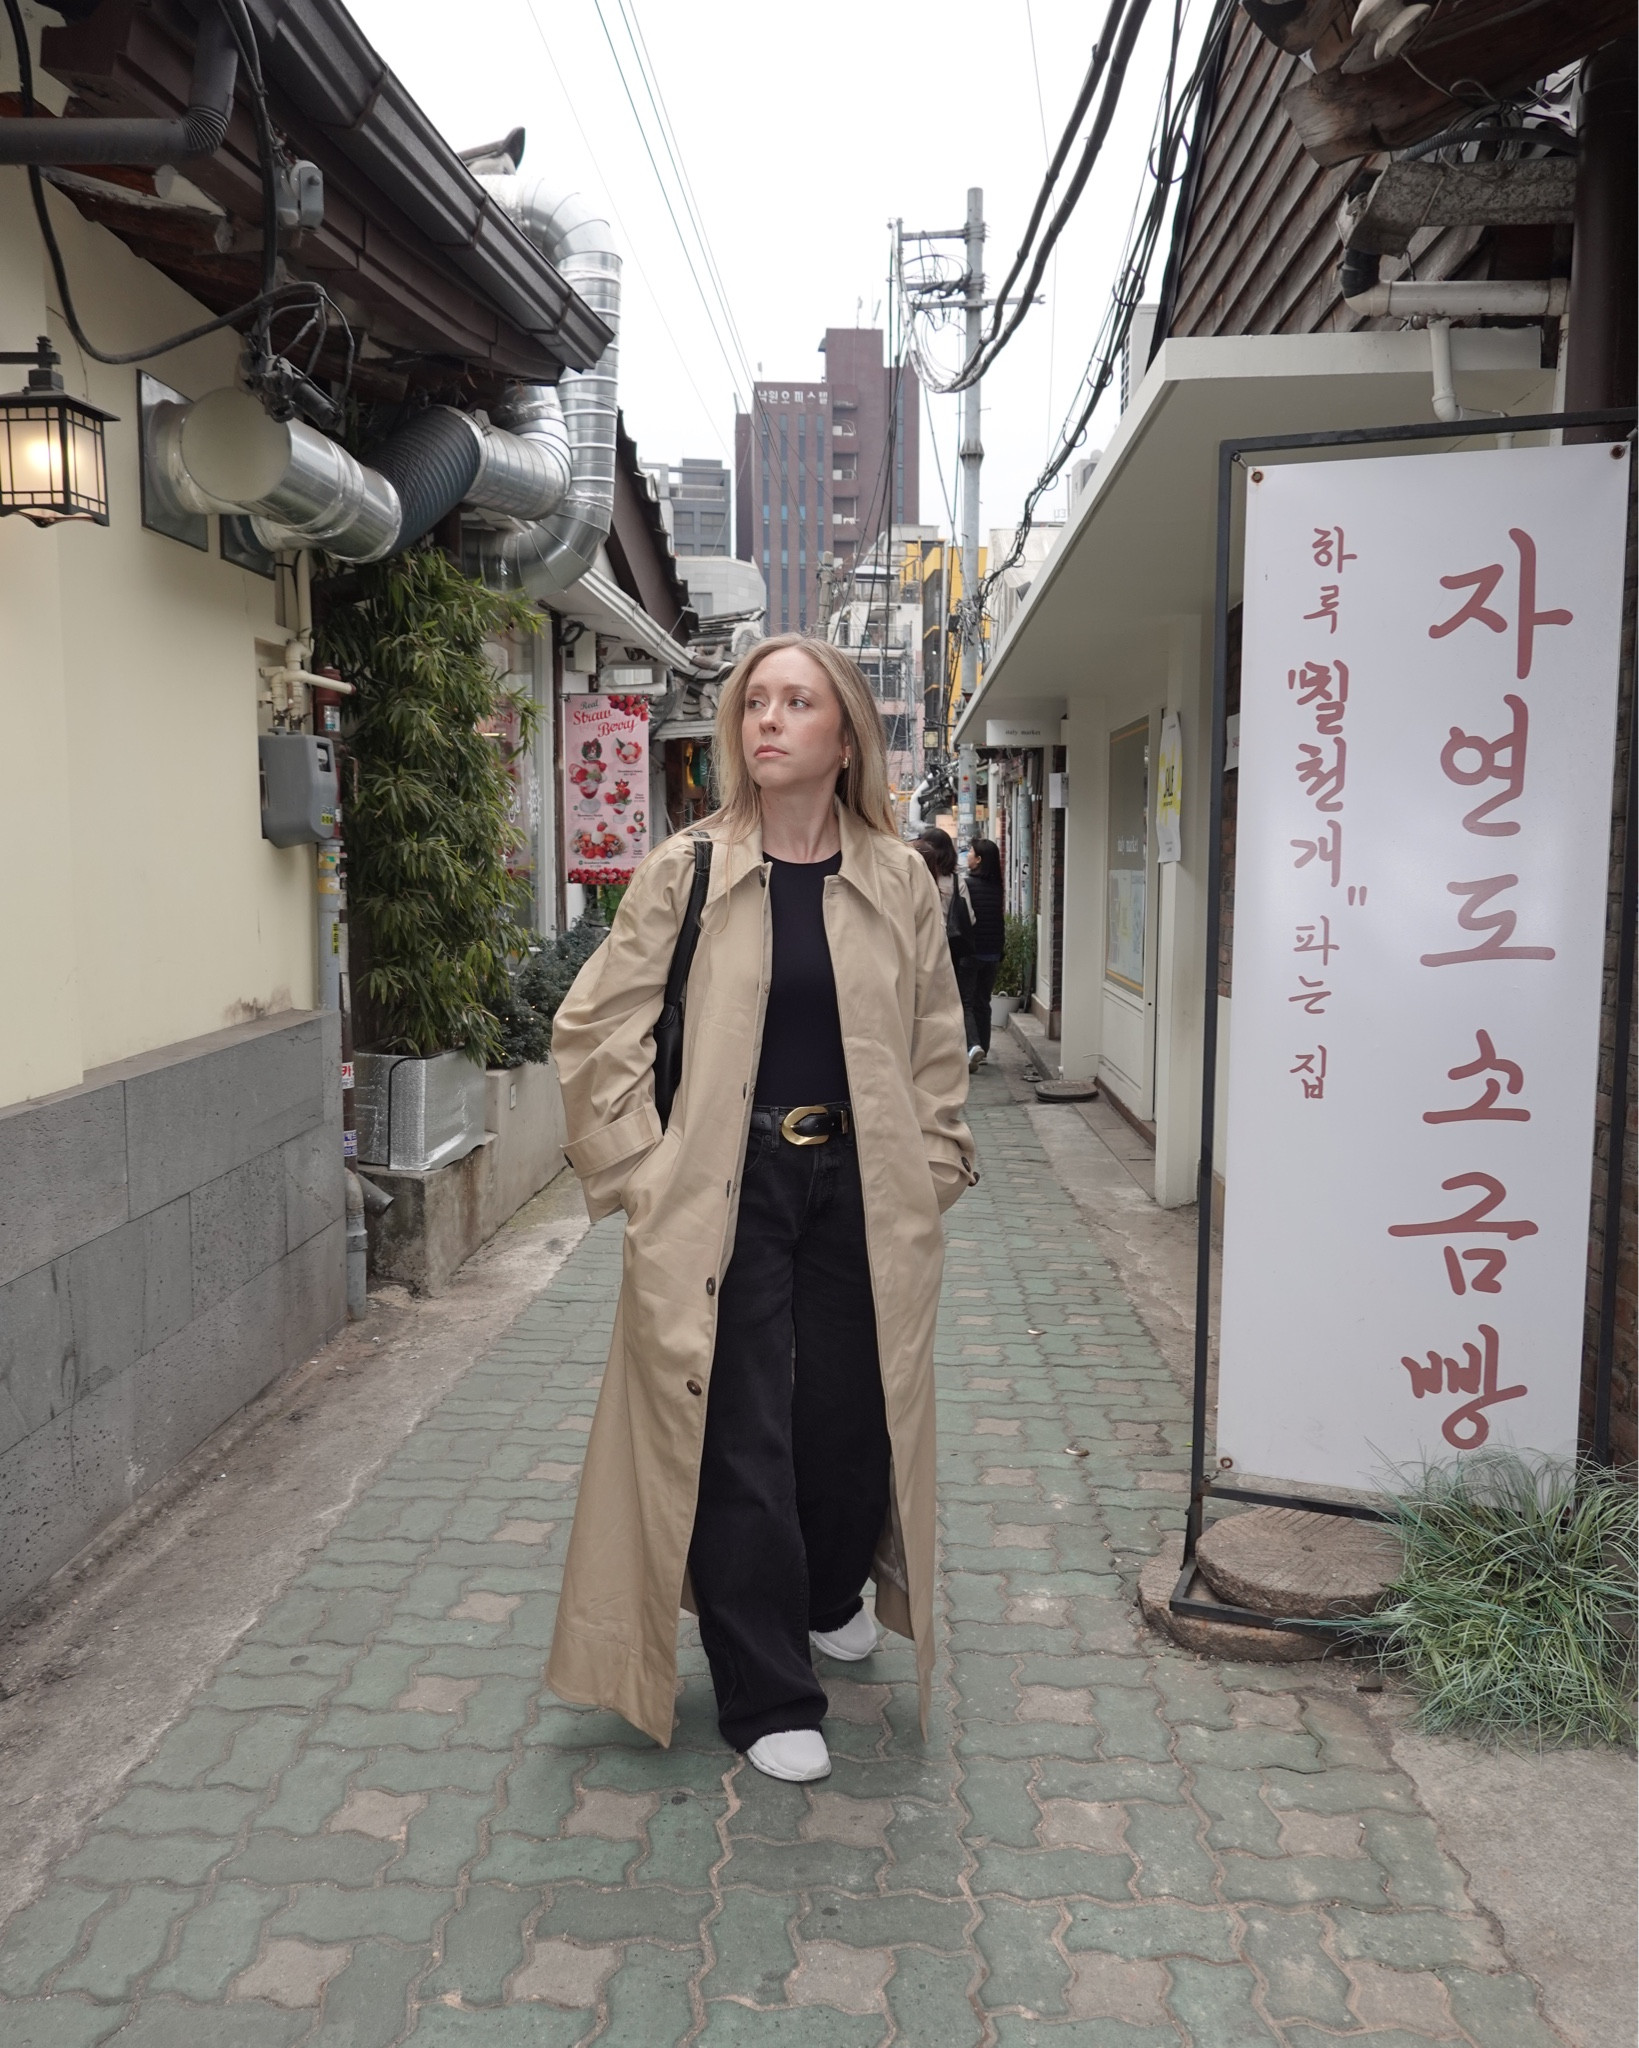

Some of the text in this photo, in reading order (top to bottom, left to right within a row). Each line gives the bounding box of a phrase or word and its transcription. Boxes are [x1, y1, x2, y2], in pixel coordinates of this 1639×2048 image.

[1303, 526, 1358, 634] 하루
[573, 709, 612, 725] Straw
[597, 719, 636, 738] Berry
[1288, 915, 1340, 1015] 파는
[1289, 1044, 1327, 1100] 집
